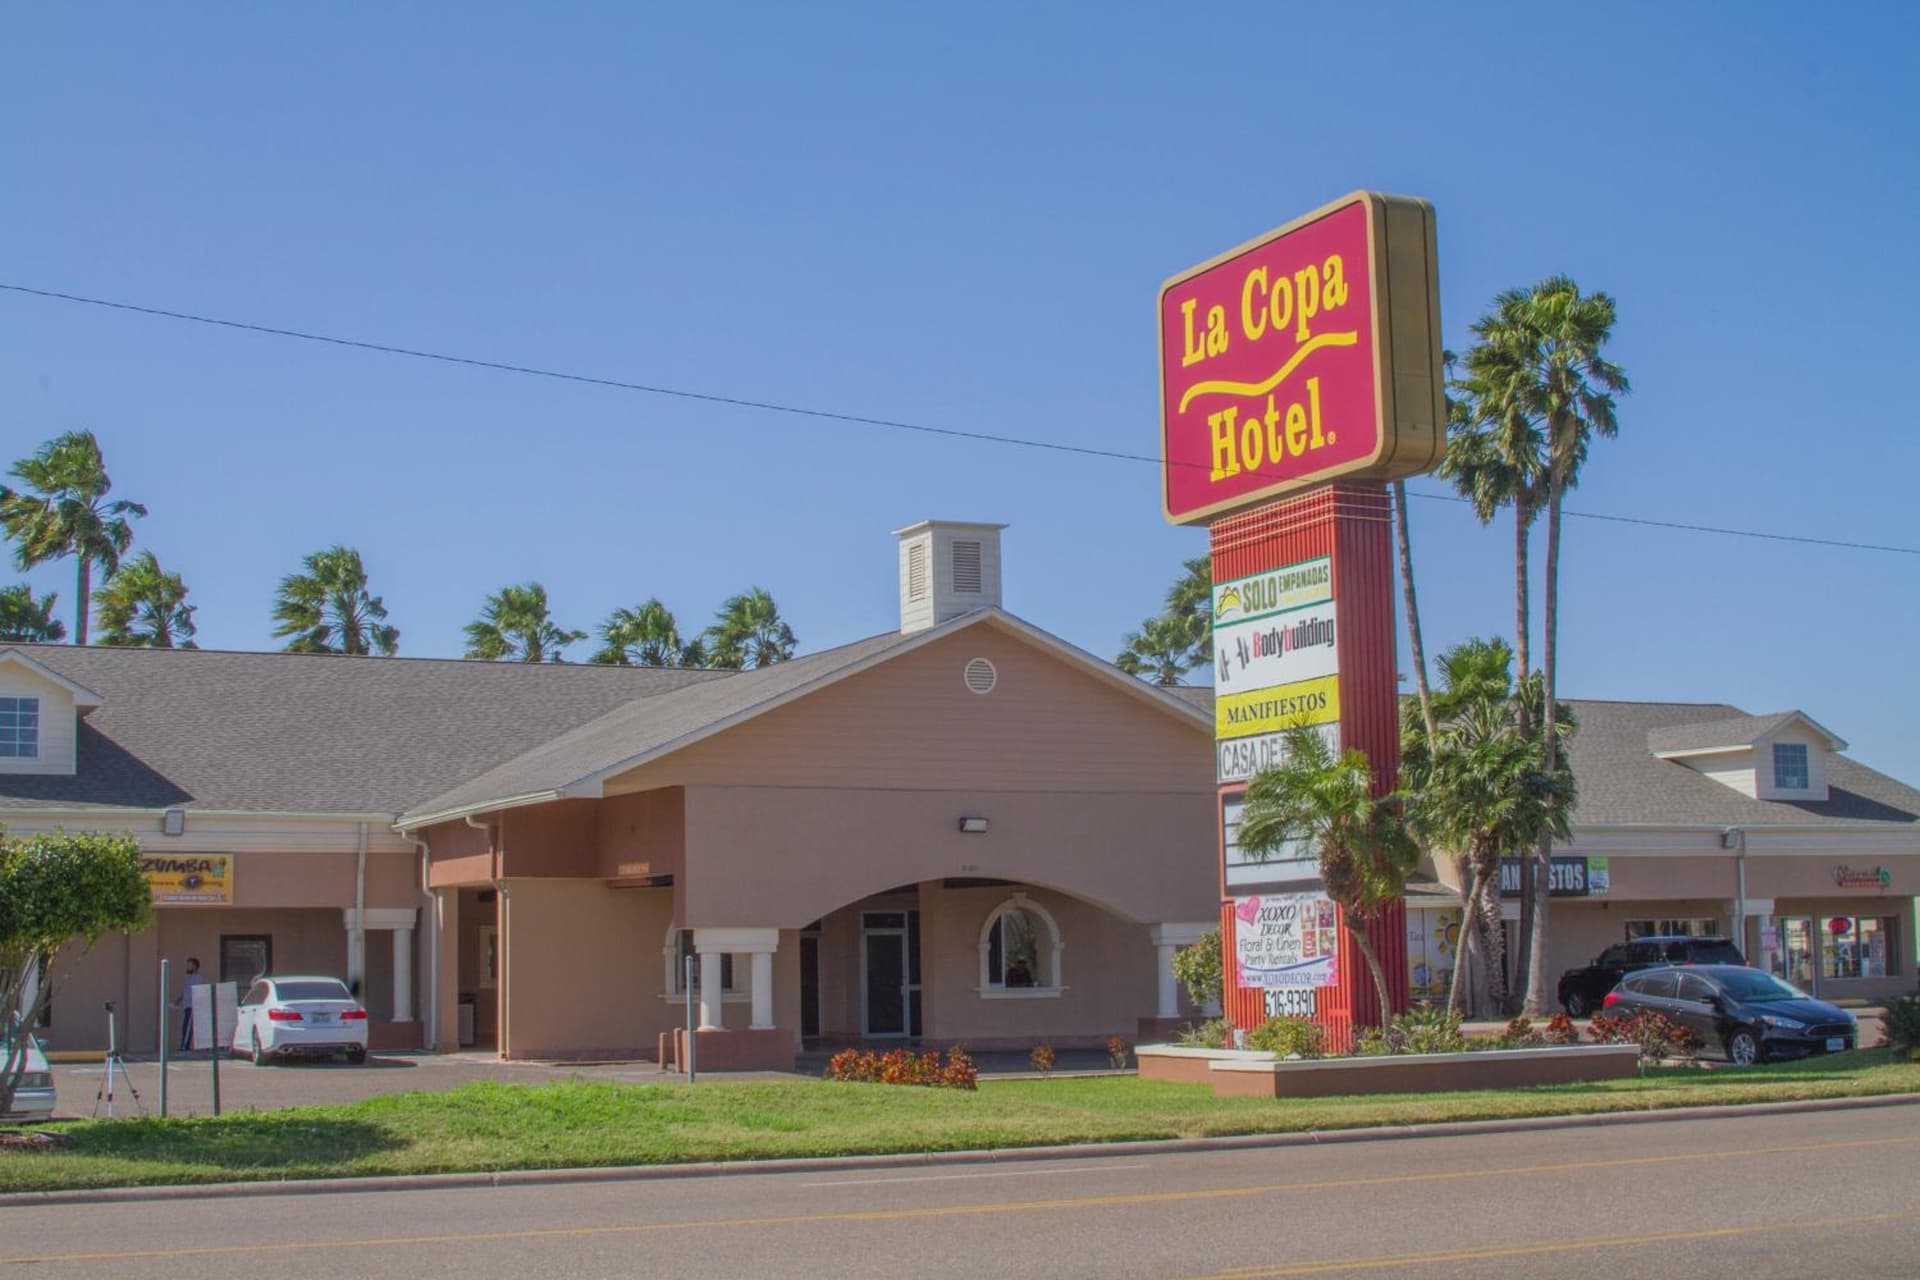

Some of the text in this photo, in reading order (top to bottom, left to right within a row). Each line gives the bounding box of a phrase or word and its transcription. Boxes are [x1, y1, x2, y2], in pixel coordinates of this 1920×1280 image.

[1181, 254, 1348, 368] La Copa
[1242, 564, 1329, 614] SOLO EMPANADAS
[1253, 616, 1335, 659] Bodybuilding
[1227, 691, 1327, 725] MANIFIESTOS
[1222, 740, 1257, 777] CASA
[143, 858, 213, 873] ZUMBA
[1258, 904, 1297, 923] XOXO
[1260, 923, 1293, 937] DECOR
[1240, 938, 1263, 952] Floral
